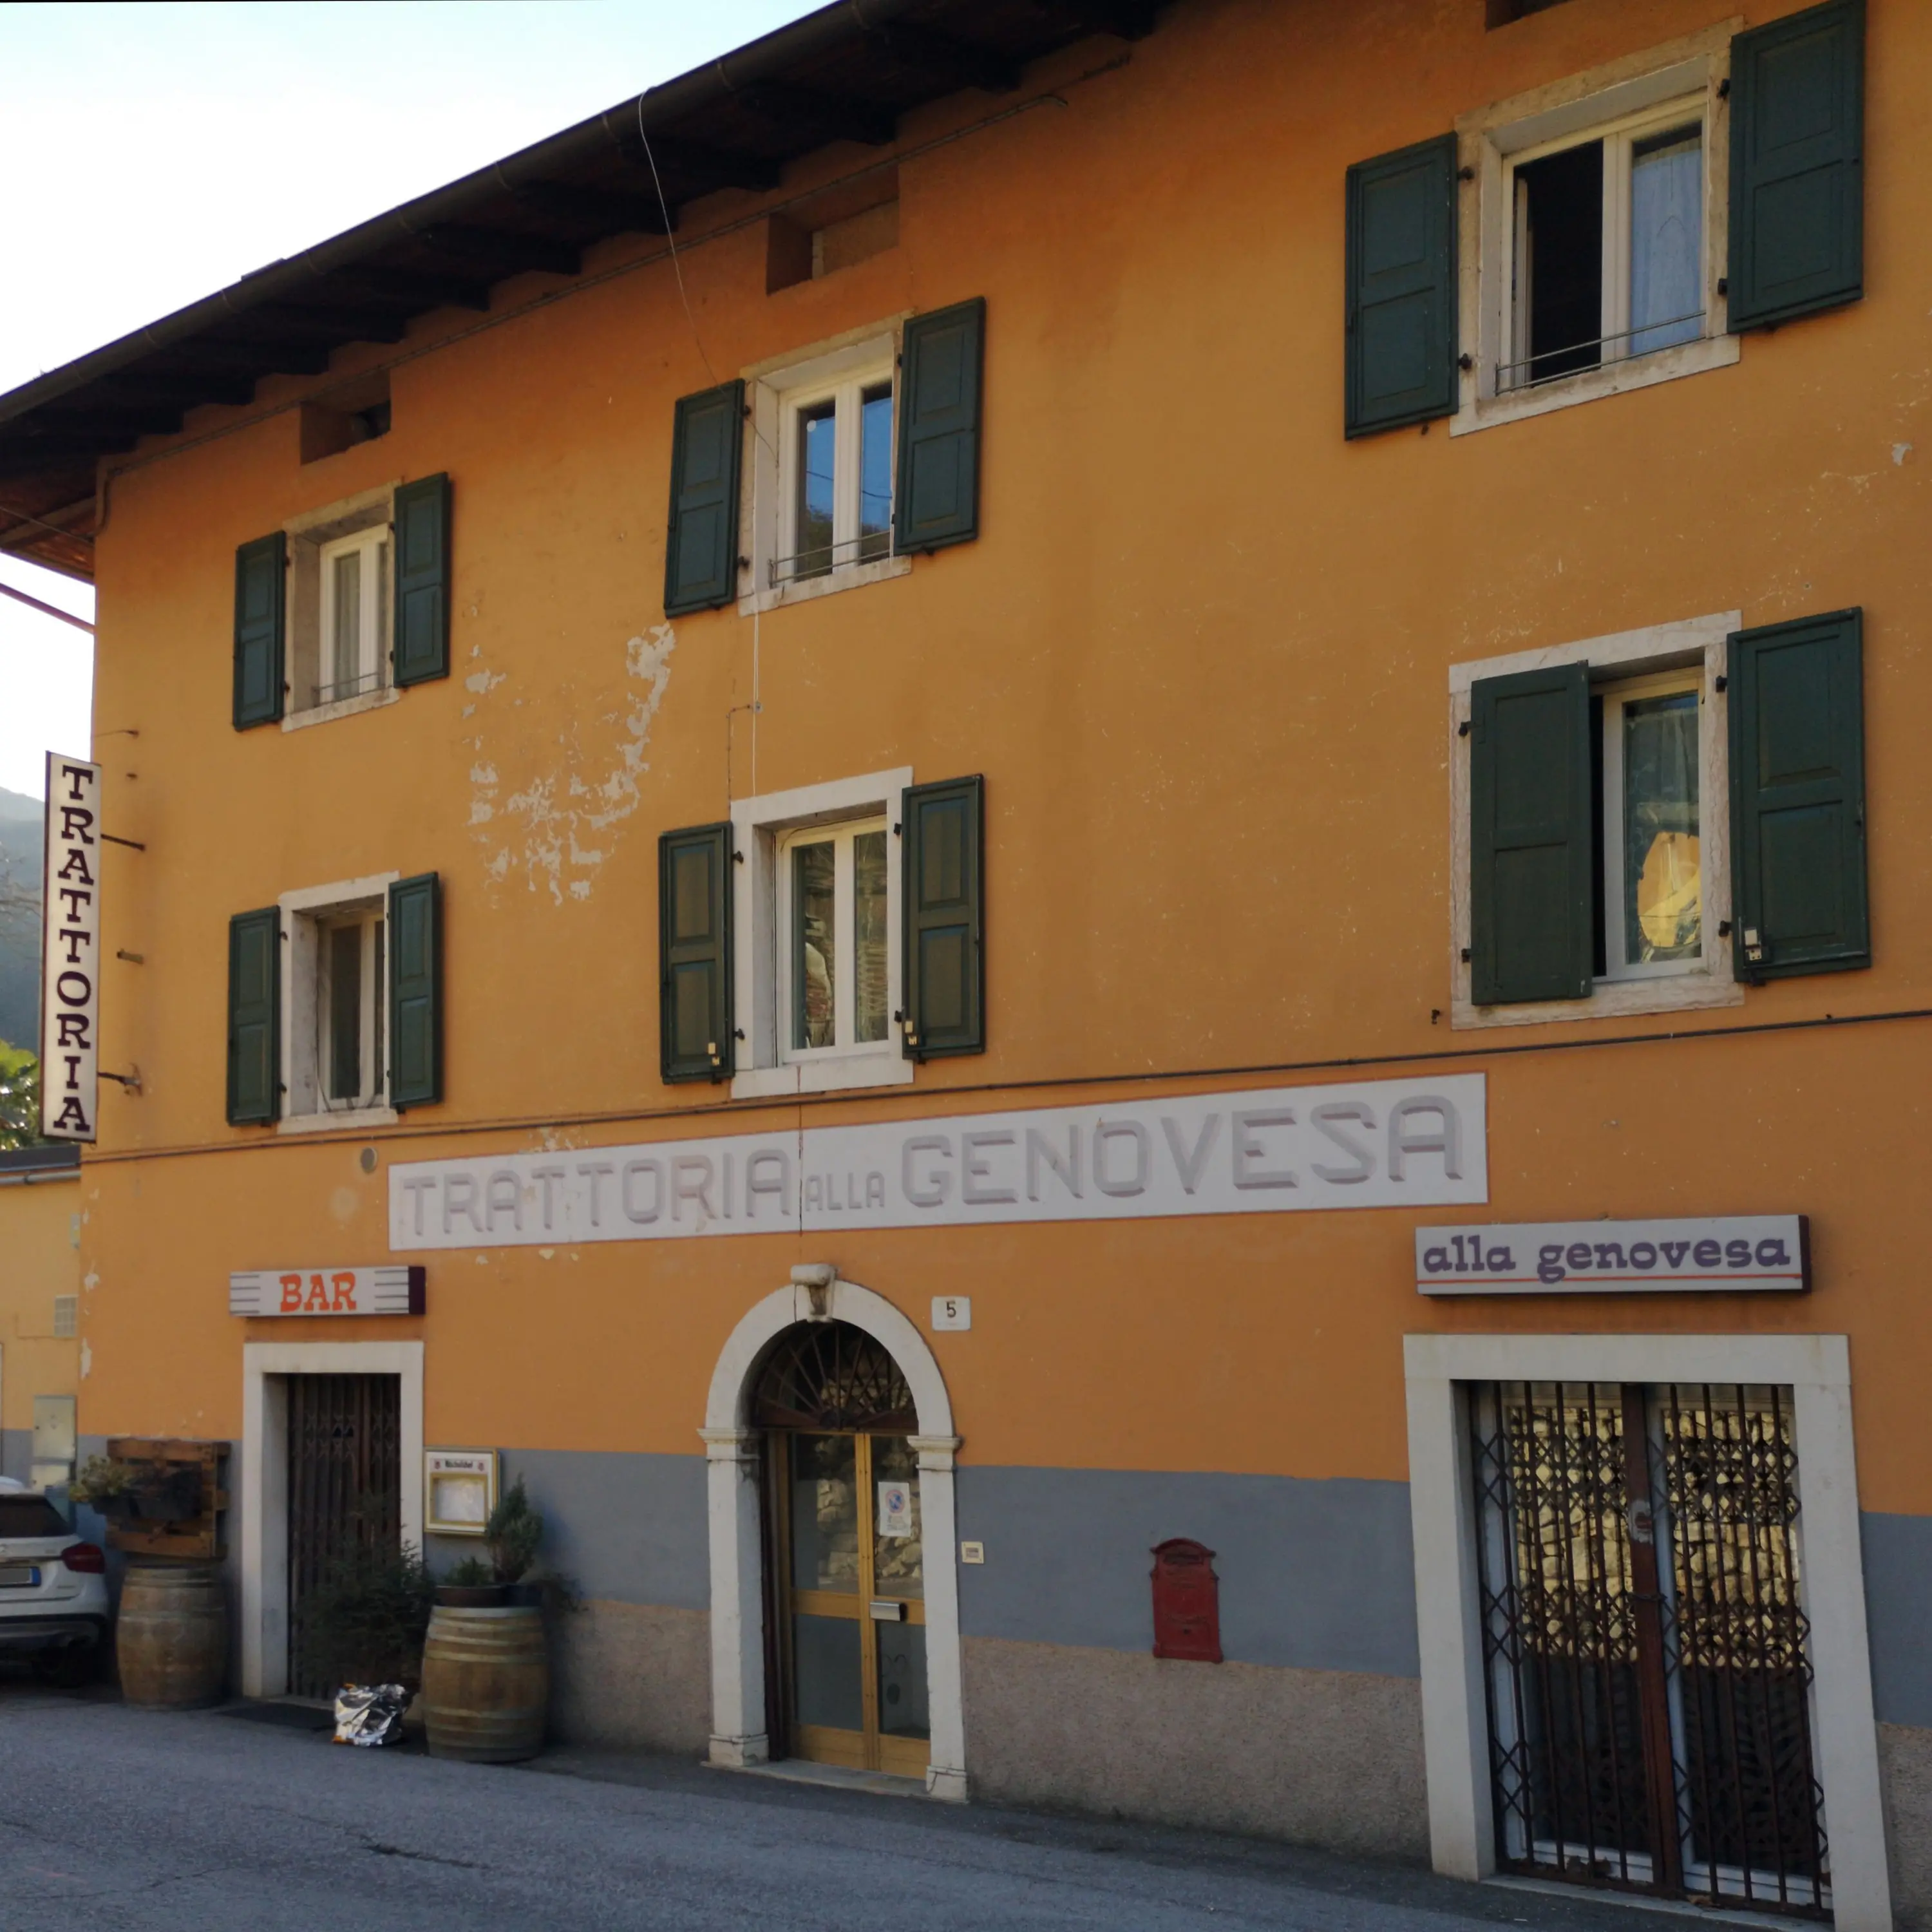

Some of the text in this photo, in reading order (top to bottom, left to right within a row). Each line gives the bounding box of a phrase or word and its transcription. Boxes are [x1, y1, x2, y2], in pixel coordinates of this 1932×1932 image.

[53, 764, 95, 1132] TRATTORIA
[403, 1095, 1463, 1236] TRATTORIA ALLA GENOVESA
[1423, 1235, 1791, 1284] alla genovesa
[279, 1271, 357, 1312] BAR
[945, 1300, 956, 1318] 5
